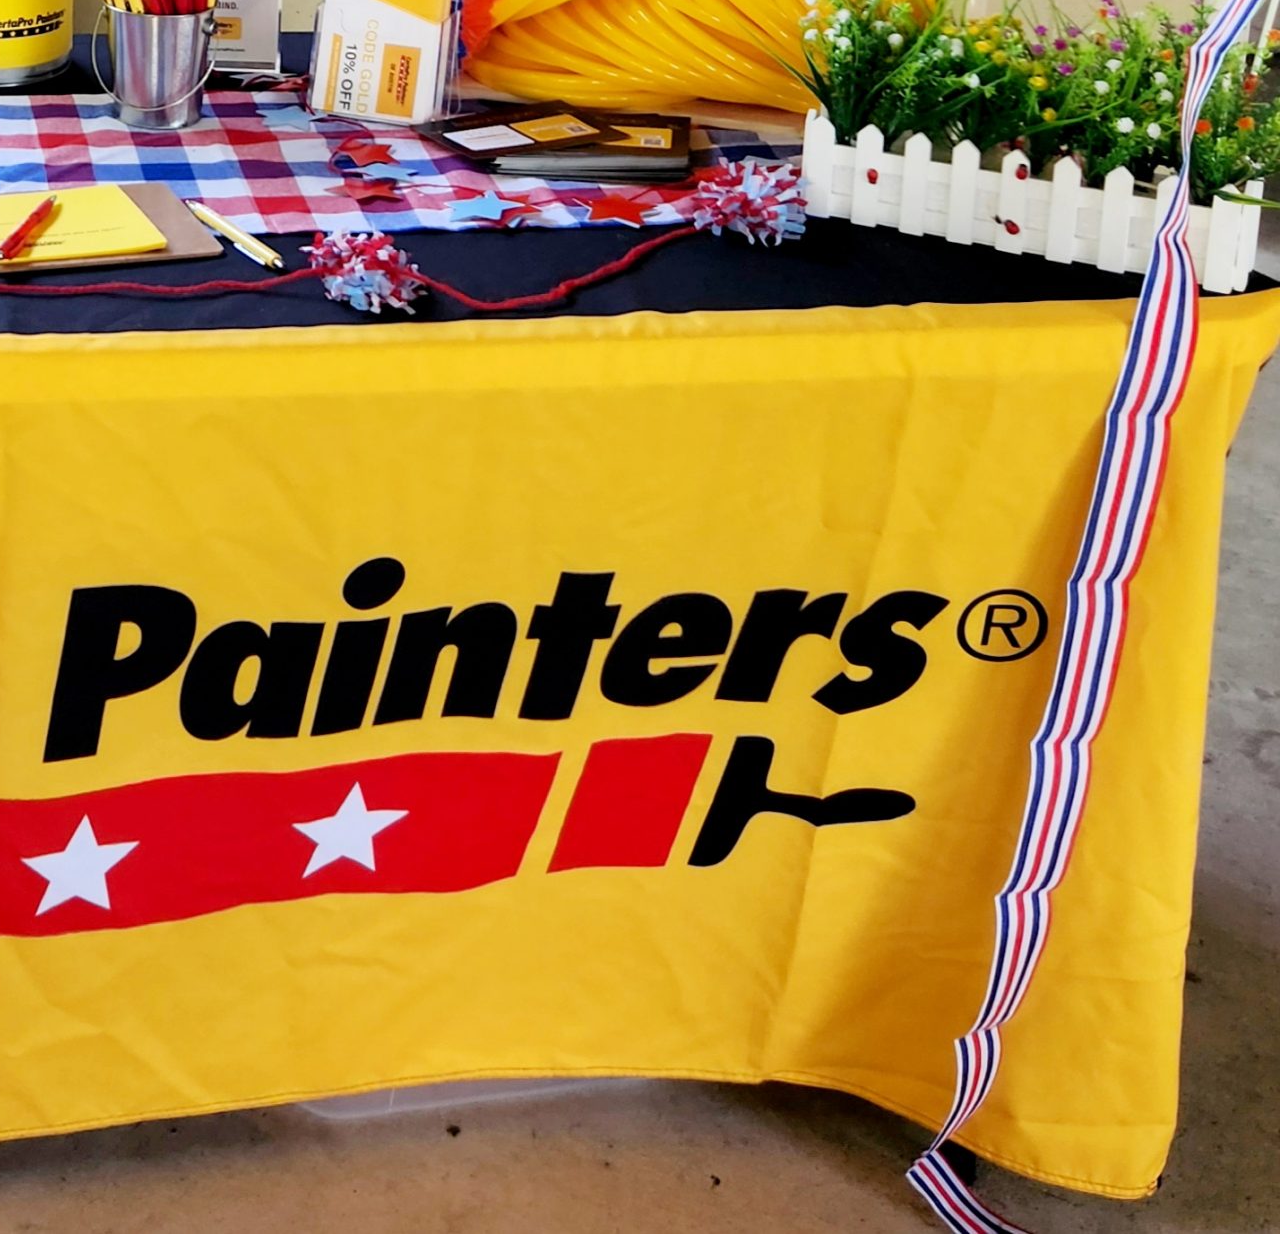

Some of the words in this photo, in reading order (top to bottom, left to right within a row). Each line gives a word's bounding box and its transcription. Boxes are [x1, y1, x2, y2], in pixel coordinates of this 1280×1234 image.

[342, 44, 358, 74] 10%
[363, 18, 379, 63] CODE
[338, 78, 354, 111] OFF
[356, 69, 373, 113] GOLD
